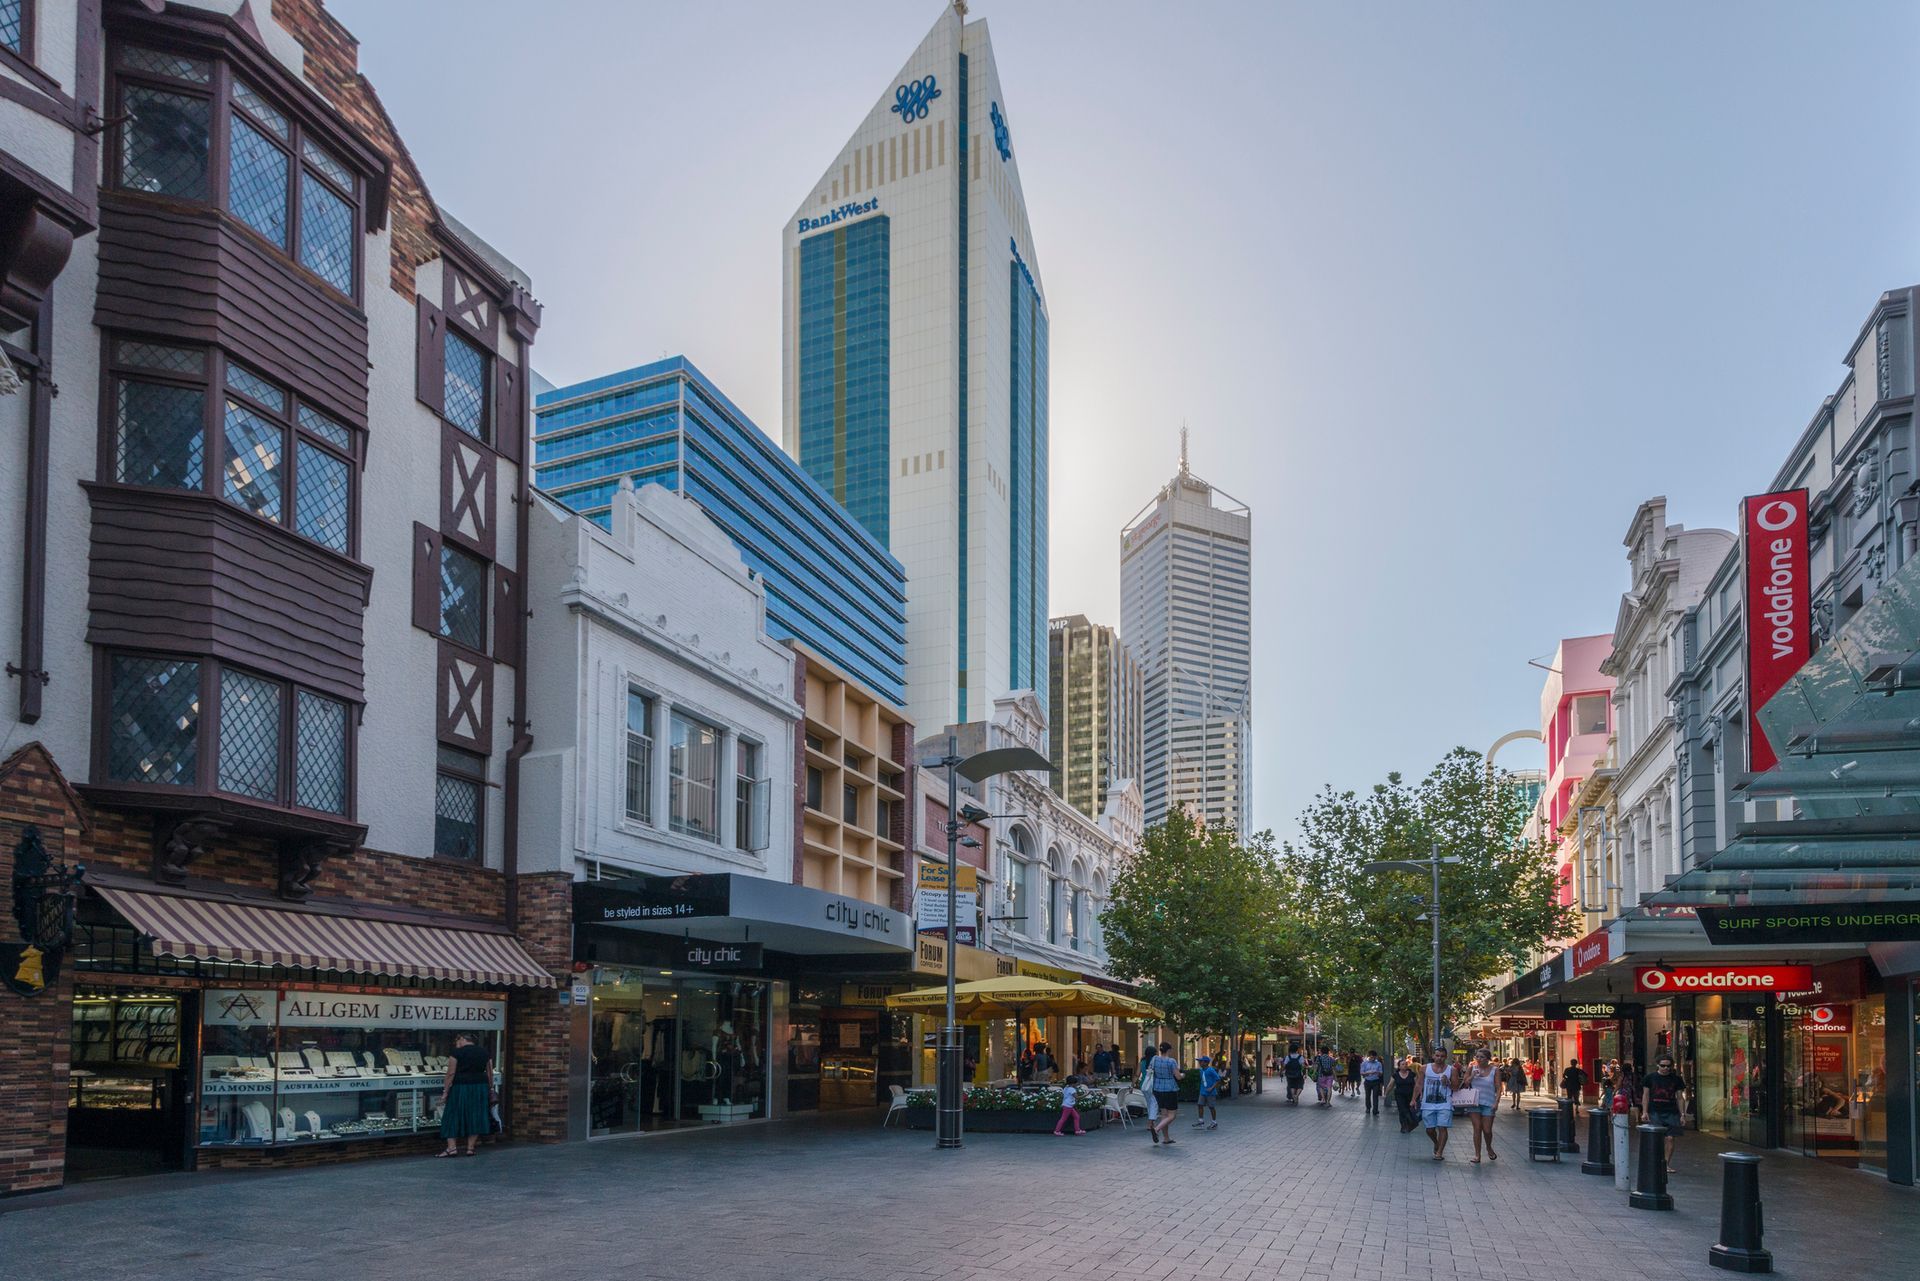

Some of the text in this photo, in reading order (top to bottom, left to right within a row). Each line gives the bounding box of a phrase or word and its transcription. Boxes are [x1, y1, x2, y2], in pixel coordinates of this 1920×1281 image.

[798, 196, 879, 234] BankWest
[1763, 538, 1794, 661] vodafone
[921, 866, 936, 874] For
[921, 874, 946, 882] Lease
[604, 903, 695, 919] be styled in sizes 14+
[826, 900, 890, 933] city chic
[1718, 917, 1761, 929] SURF
[1766, 915, 1832, 928] SPORTS
[688, 946, 741, 965] city chic
[1672, 971, 1774, 987] vodafone
[1044, 989, 1063, 999] Shop
[287, 1000, 498, 1022] ALLGEM JEWELLERS
[1568, 1003, 1615, 1014] colette
[1509, 1019, 1555, 1030] ESPRIT
[1798, 1023, 1847, 1032] vodafone
[204, 1084, 272, 1093] DIAMONDS
[284, 1082, 341, 1090] AUSTRALIAN
